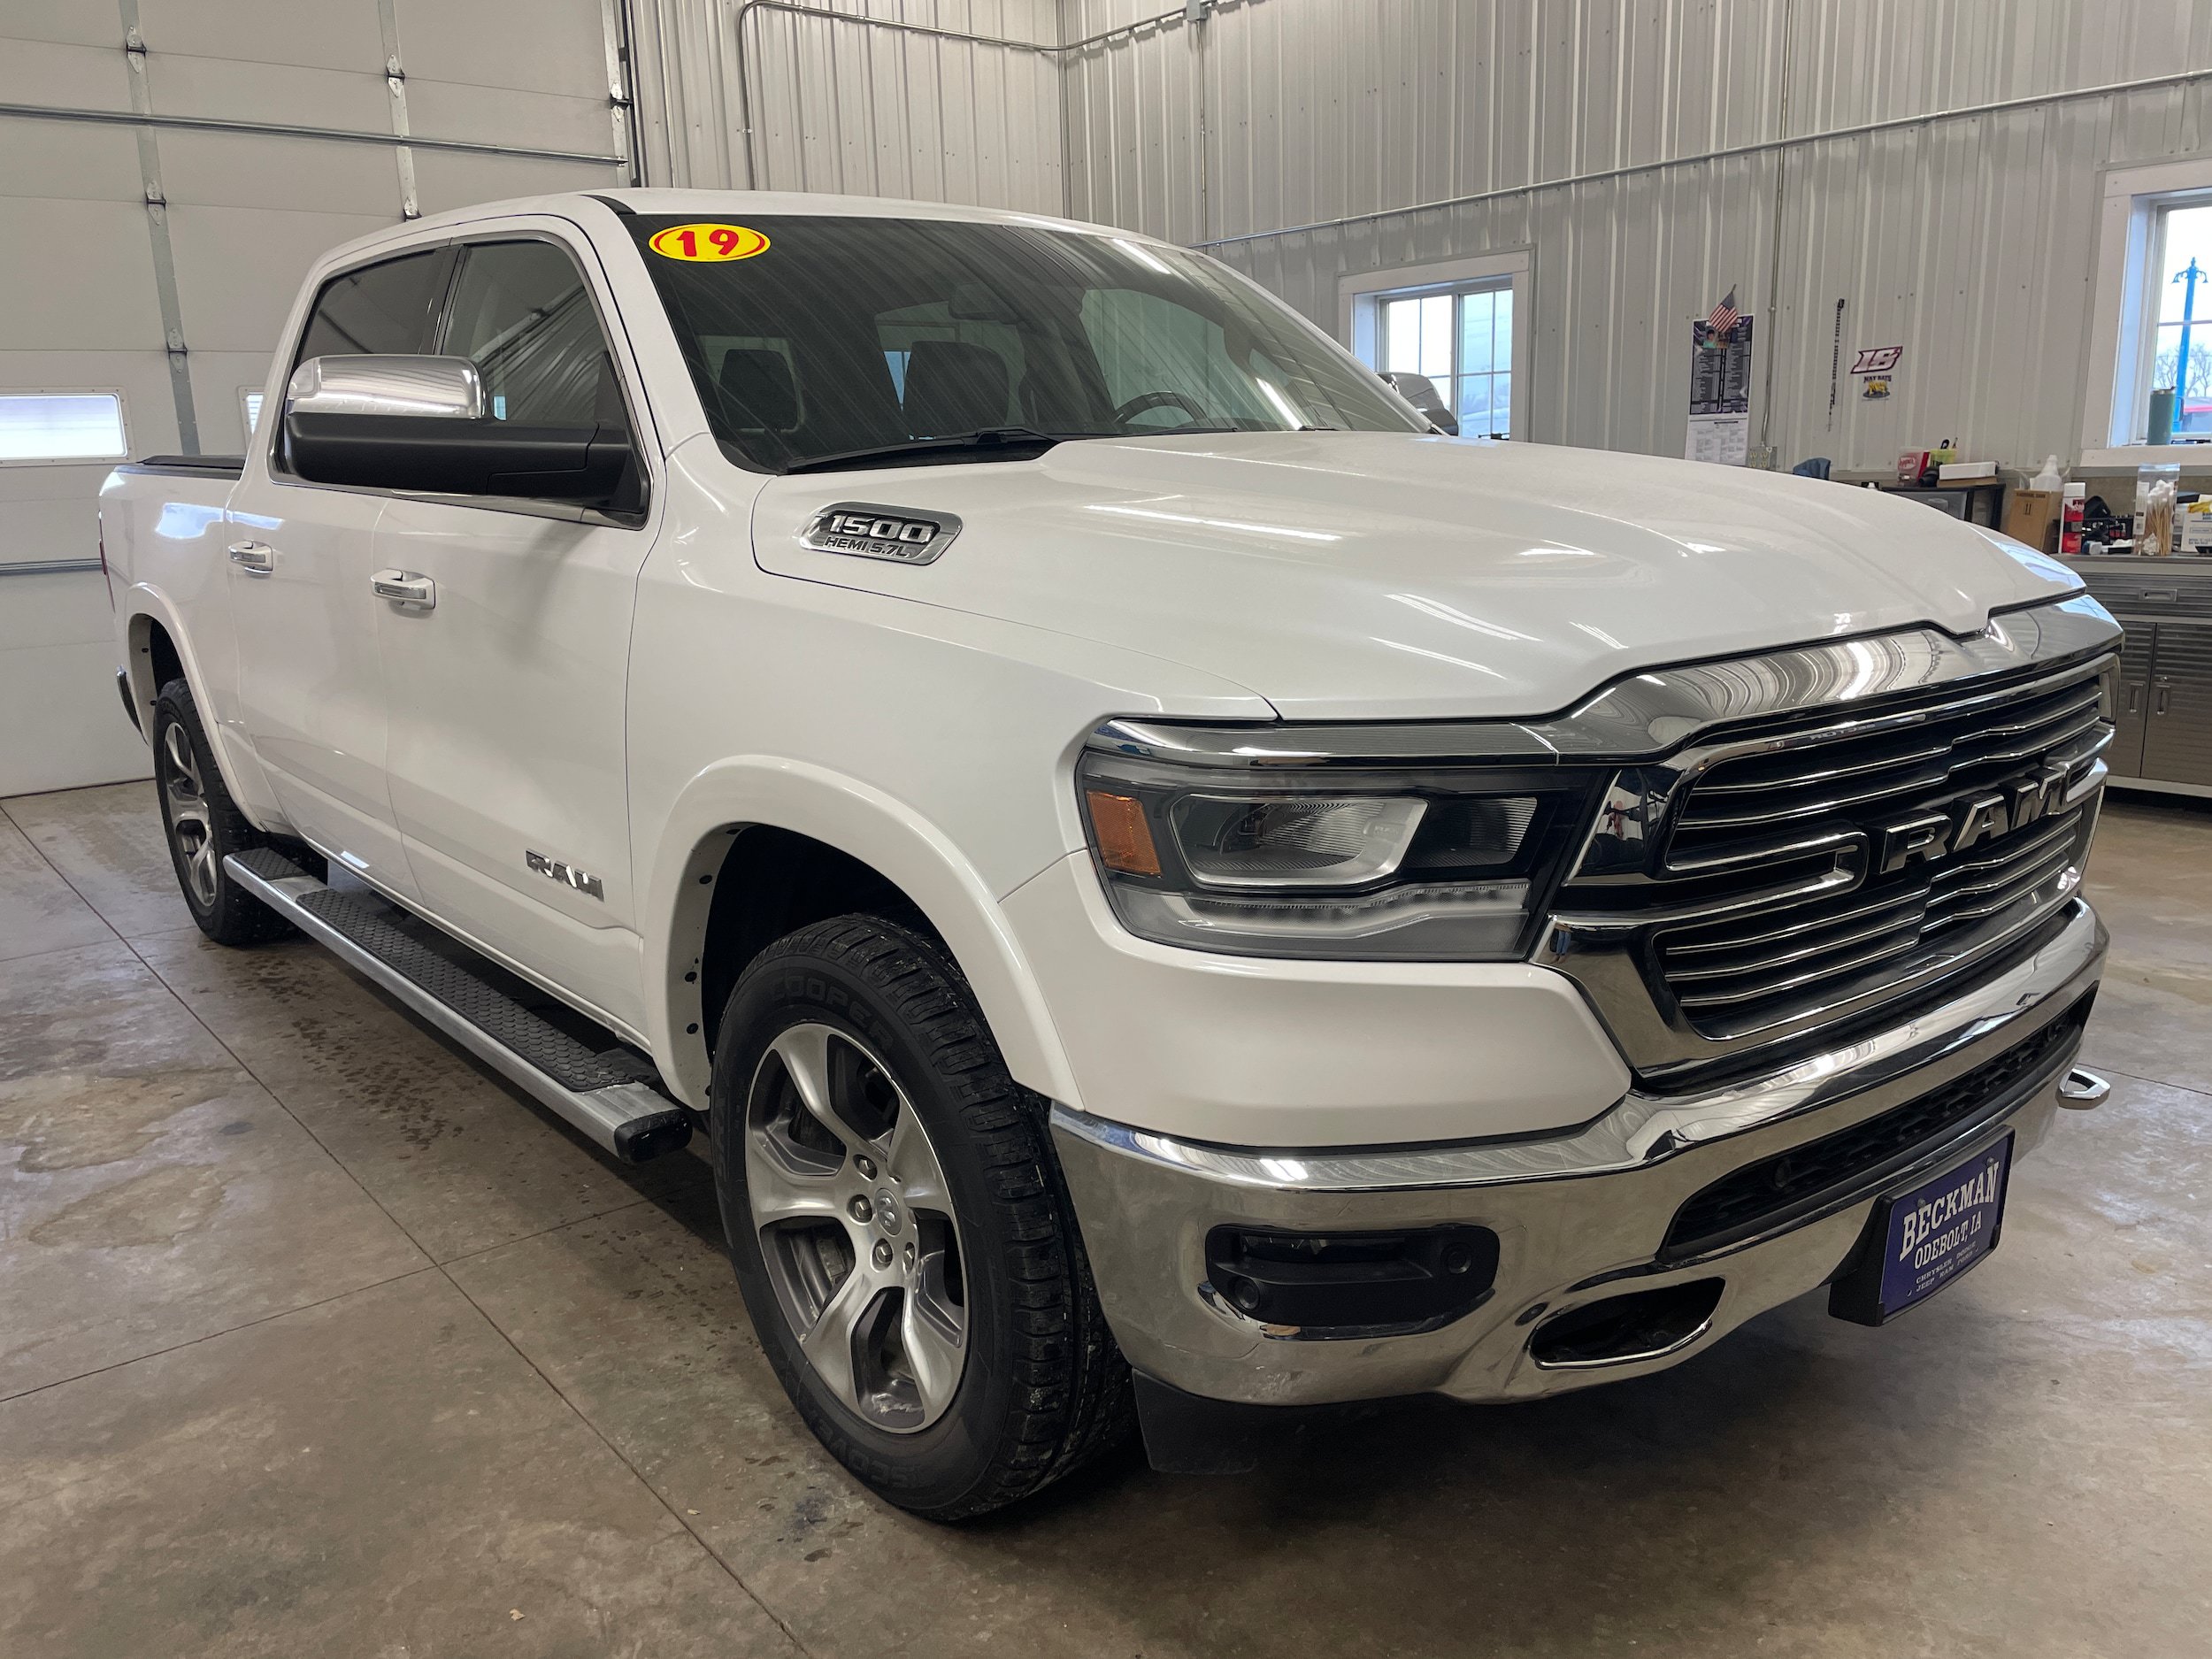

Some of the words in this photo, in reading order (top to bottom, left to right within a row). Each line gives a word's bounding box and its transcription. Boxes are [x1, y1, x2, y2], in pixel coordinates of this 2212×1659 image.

[676, 229, 740, 257] 19
[824, 535, 867, 552] HEMI
[871, 542, 910, 558] 5.7L
[829, 514, 935, 543] 1500
[1879, 768, 2066, 874] RAM
[526, 848, 604, 902] RAM
[771, 974, 895, 1052] COOPER
[1899, 1161, 2000, 1262] BECKMAN
[1914, 1220, 1970, 1270] ODEBOLT,
[1970, 1210, 1982, 1235] IA
[1916, 1258, 1953, 1284] CHRYSLER
[1916, 1277, 1935, 1292] JEEP
[1939, 1263, 1955, 1278] RAM
